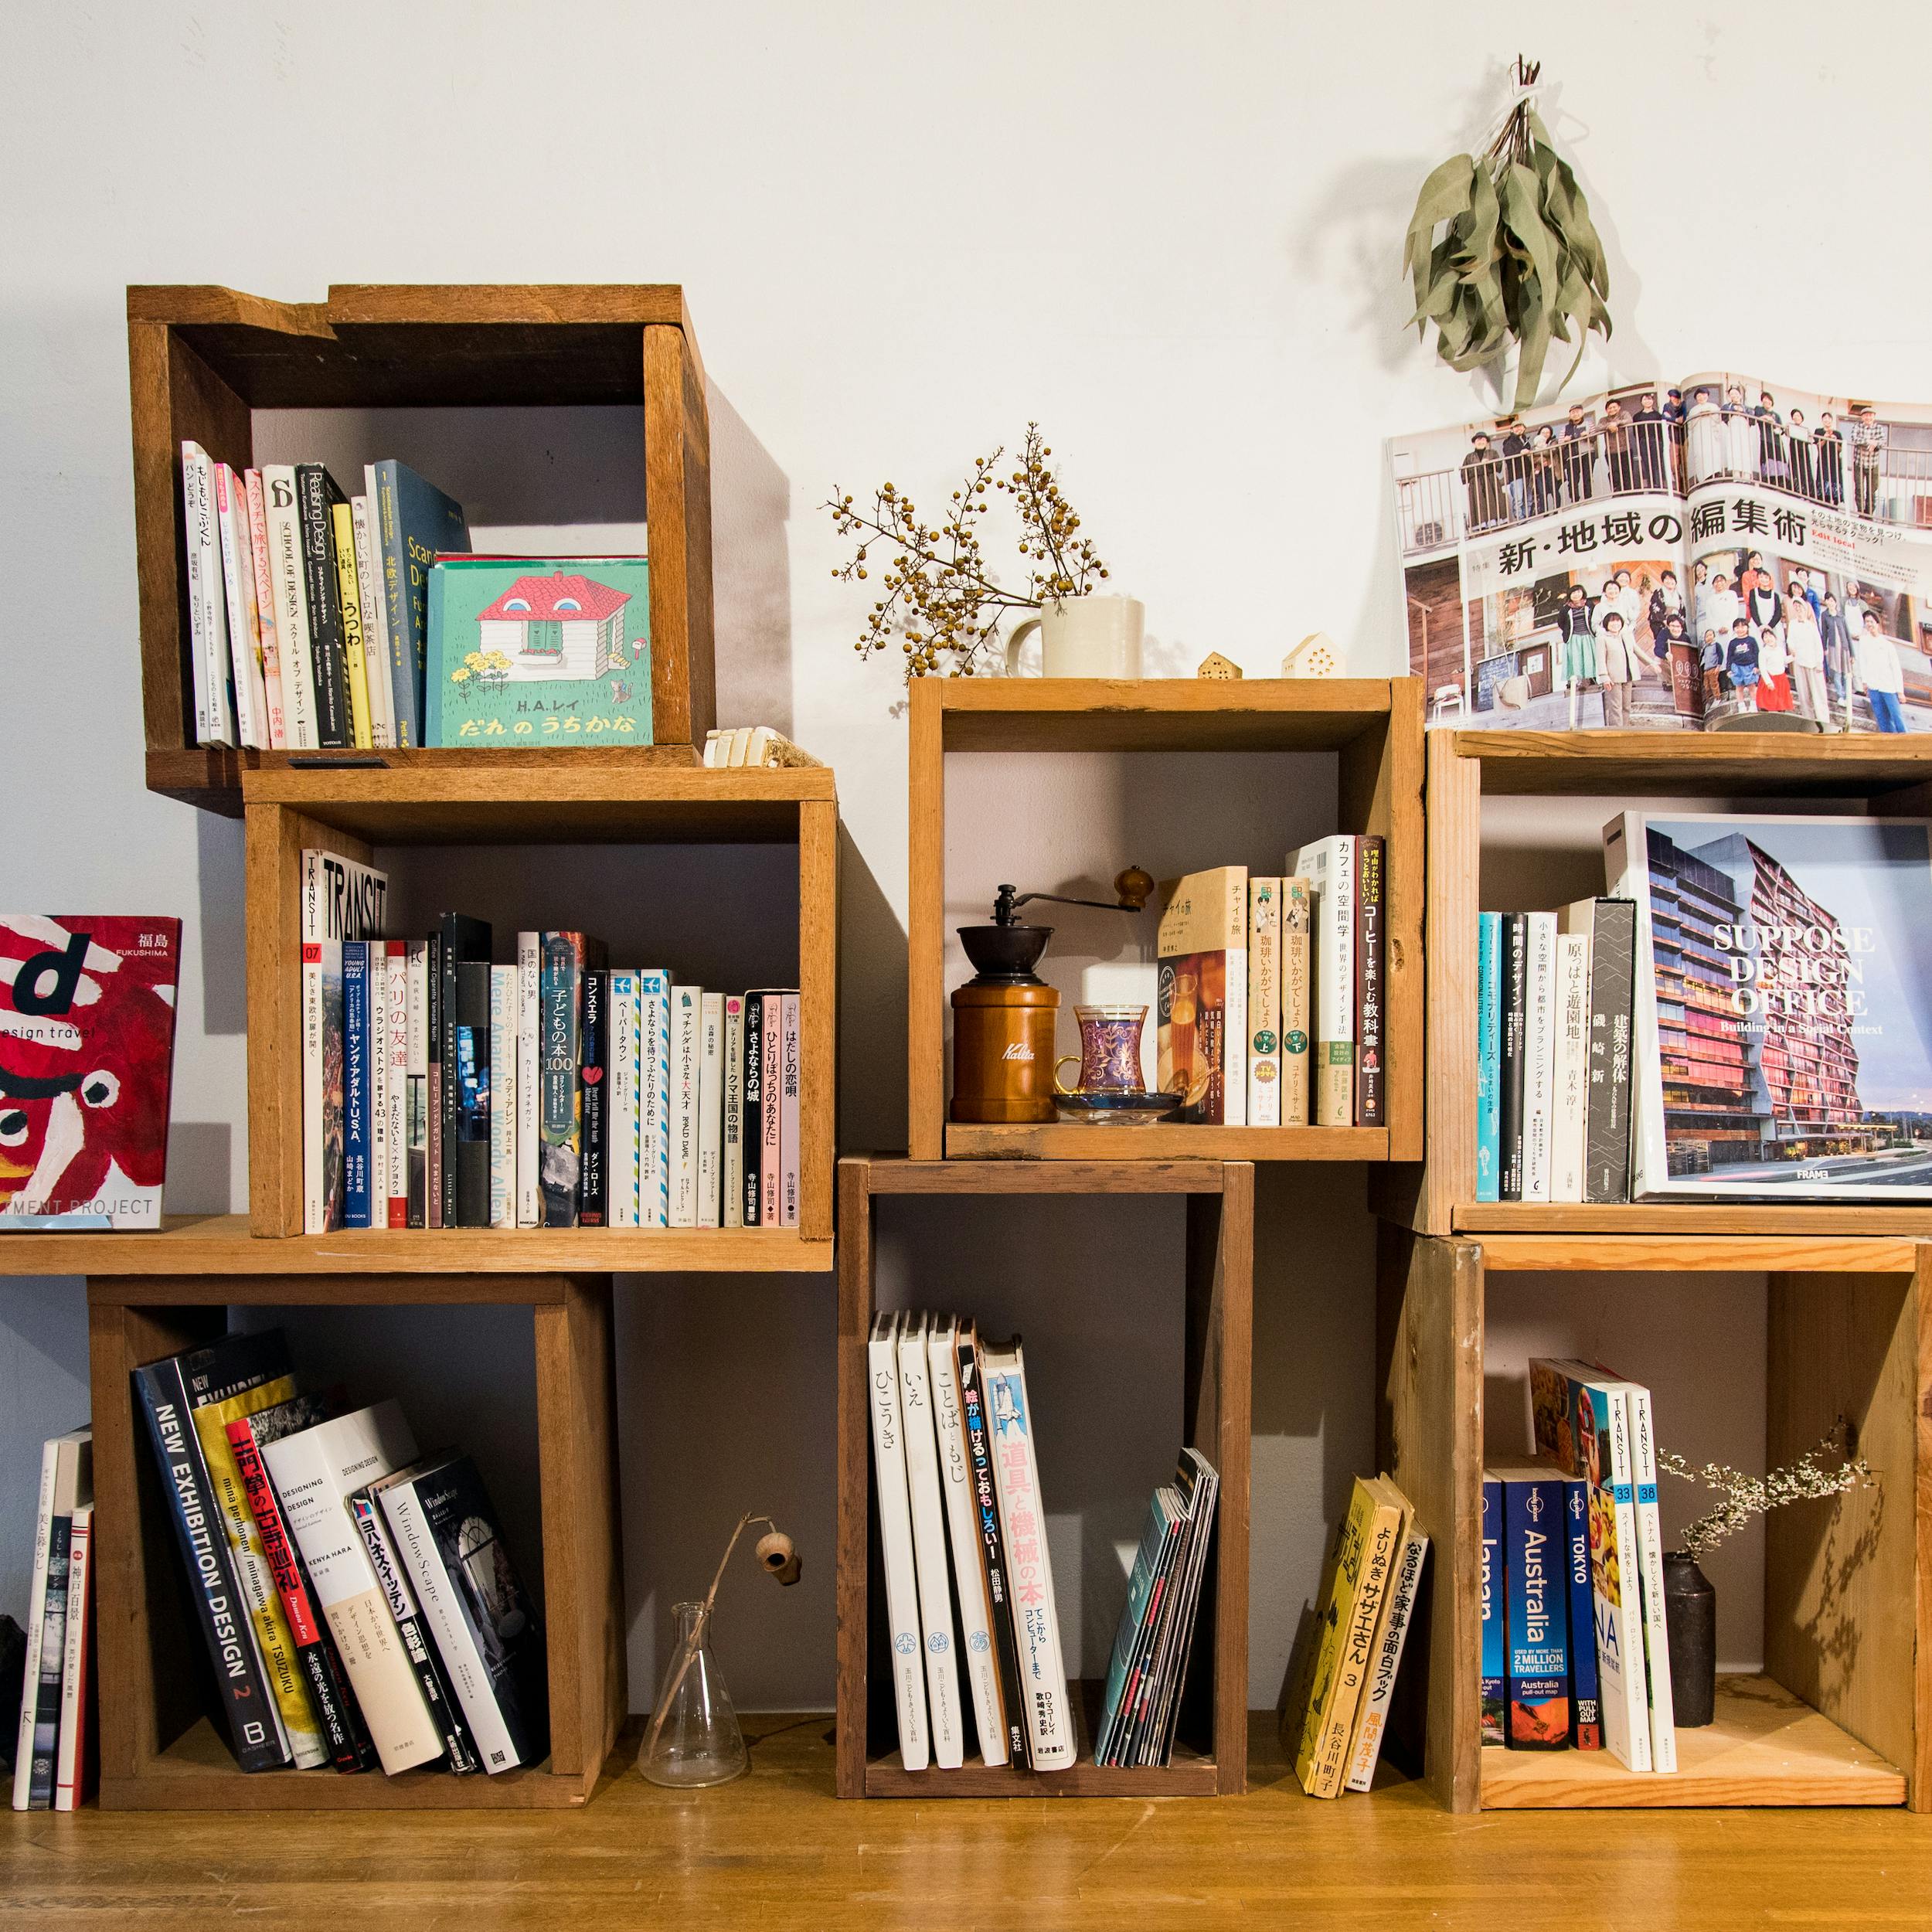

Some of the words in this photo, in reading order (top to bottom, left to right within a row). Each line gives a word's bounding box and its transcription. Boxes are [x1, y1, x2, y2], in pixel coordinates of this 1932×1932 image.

[250, 480, 272, 610] スケッチで旅するスペイン
[281, 522, 294, 564] SCHOOL
[312, 521, 328, 562] Design
[1811, 529, 1831, 541] Edit
[1833, 534, 1855, 549] local
[287, 565, 294, 577] OF
[386, 556, 401, 627] 北欧デザイン
[287, 578, 299, 619] DESIGN
[290, 623, 300, 655] スクール
[344, 601, 361, 647] うつわ
[292, 660, 301, 679] オフ
[294, 682, 304, 716] デザイン
[308, 856, 317, 937] TRANSIT
[1337, 841, 1350, 937] カフェの空間学
[1370, 849, 1379, 903] 理由がわかれば
[324, 858, 386, 942] TRANSIT
[1231, 885, 1243, 936] チャイの旅
[116, 949, 168, 957] FUKUSHIMA
[138, 933, 168, 947] 福島
[305, 947, 318, 961] 07
[1713, 923, 1876, 954] SUPPOSE
[527, 949, 537, 1000] 国のない男
[1260, 935, 1272, 1029] 珈琲いかがでしょう
[1291, 934, 1303, 1029] 珈琲いかがでしょう
[1362, 906, 1379, 1048] コーヒーを楽しむ教科書
[1512, 922, 1524, 1006] 時間のデザイン
[1729, 955, 1865, 986] DESIGN
[491, 971, 505, 1016] Mere
[587, 977, 597, 1024] コンスエラ
[1565, 942, 1583, 1040] 原っぱと遊園地
[1730, 987, 1869, 1018] OFFICE
[50, 1026, 96, 1039] travel
[308, 971, 318, 1058] 美しき東欧の扉が開く
[389, 971, 408, 1066] パリの友達
[551, 989, 568, 1056] 子どもの本
[618, 1001, 628, 1063] ペーパータウン
[1719, 1021, 1770, 1036] Building
[1772, 1021, 1785, 1035] in
[1787, 1024, 1795, 1035] a
[1798, 1022, 1834, 1035] Social
[1835, 1022, 1883, 1036] Context
[490, 1022, 505, 1093] Anarchy
[546, 1056, 573, 1071] 100
[646, 1001, 656, 1126] さよならを待つふたりのために
[681, 1012, 692, 1110] マチルダは小さな大天才
[747, 1031, 760, 1102] さよならの城
[784, 1031, 798, 1097] はだしの恋唄
[1001, 1043, 1036, 1061] Kalita
[1259, 1043, 1269, 1053] 上
[1291, 1043, 1302, 1053] 下
[1612, 1013, 1630, 1084] 建築の解体
[766, 1032, 778, 1146] ひとりぼっちのあなたに
[490, 1110, 505, 1169] Woody
[590, 1152, 598, 1196] ダン・ローズ
[70, 1199, 153, 1215] PROJECT
[491, 1176, 505, 1219] Allen
[191, 1373, 209, 1393] NEW
[904, 1372, 923, 1408] いえ
[875, 1369, 896, 1450] ひこうき
[1614, 1398, 1625, 1478] TRANSIT
[1638, 1398, 1649, 1477] TRANSIT
[281, 1478, 324, 1499] DESIGNING
[341, 1461, 366, 1478] DESIGNING
[363, 1455, 379, 1468] DESIGN
[287, 1496, 315, 1512] DESIGN
[1616, 1487, 1631, 1499] 33
[1641, 1487, 1655, 1499] 38
[1000, 1440, 1046, 1607] 道具と機械の本
[1645, 1512, 1655, 1543] ベトナム
[155, 1404, 186, 1454] NEW
[172, 1461, 223, 1588] EXHIBITION
[208, 1594, 247, 1679] DESIGN
[233, 1685, 252, 1700] 2
[308, 1553, 332, 1566] KENYA
[331, 1546, 352, 1558] HARA
[360, 1519, 406, 1617] ヨハネス・イッテン
[1572, 1534, 1588, 1584] TOKYO
[231, 1504, 251, 1554] perhonen
[247, 1560, 268, 1614] minagawa
[263, 1614, 277, 1642] akira
[272, 1643, 294, 1694] TSUZUKU
[990, 1567, 1004, 1604] 松田静男
[1524, 1529, 1550, 1643] Australia
[288, 1596, 303, 1625] Domon
[298, 1624, 309, 1640] Ken
[1034, 1607, 1047, 1644] てこから
[1371, 1541, 1424, 1703] なるほど家事の面白ブック
[1025, 1610, 1042, 1681] コンピューターまで
[1514, 1655, 1521, 1665] 2
[1522, 1654, 1563, 1665] MILLION
[1343, 1673, 1357, 1687] 3
[1514, 1663, 1565, 1674] TRAVELLERS
[1520, 1680, 1560, 1689] Australia
[307, 1651, 345, 1746] 永遠の光を放つ名作
[1318, 1722, 1345, 1792] 長谷川町子
